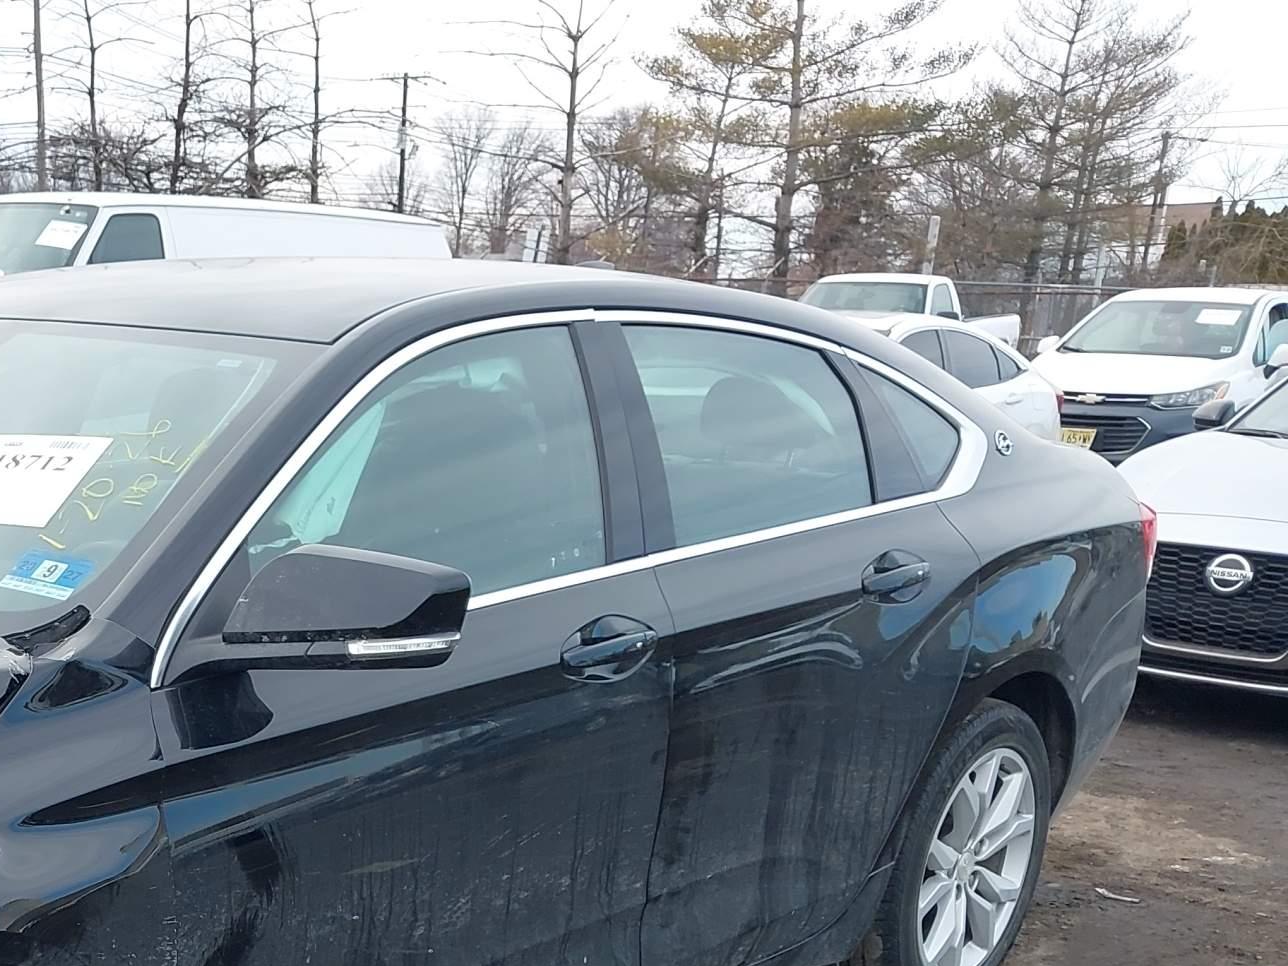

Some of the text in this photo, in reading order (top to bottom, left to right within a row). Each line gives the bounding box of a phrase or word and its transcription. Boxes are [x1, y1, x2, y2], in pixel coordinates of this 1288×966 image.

[43, 564, 59, 578] 9
[63, 569, 82, 581] 27
[1212, 569, 1249, 580] NISSAN
